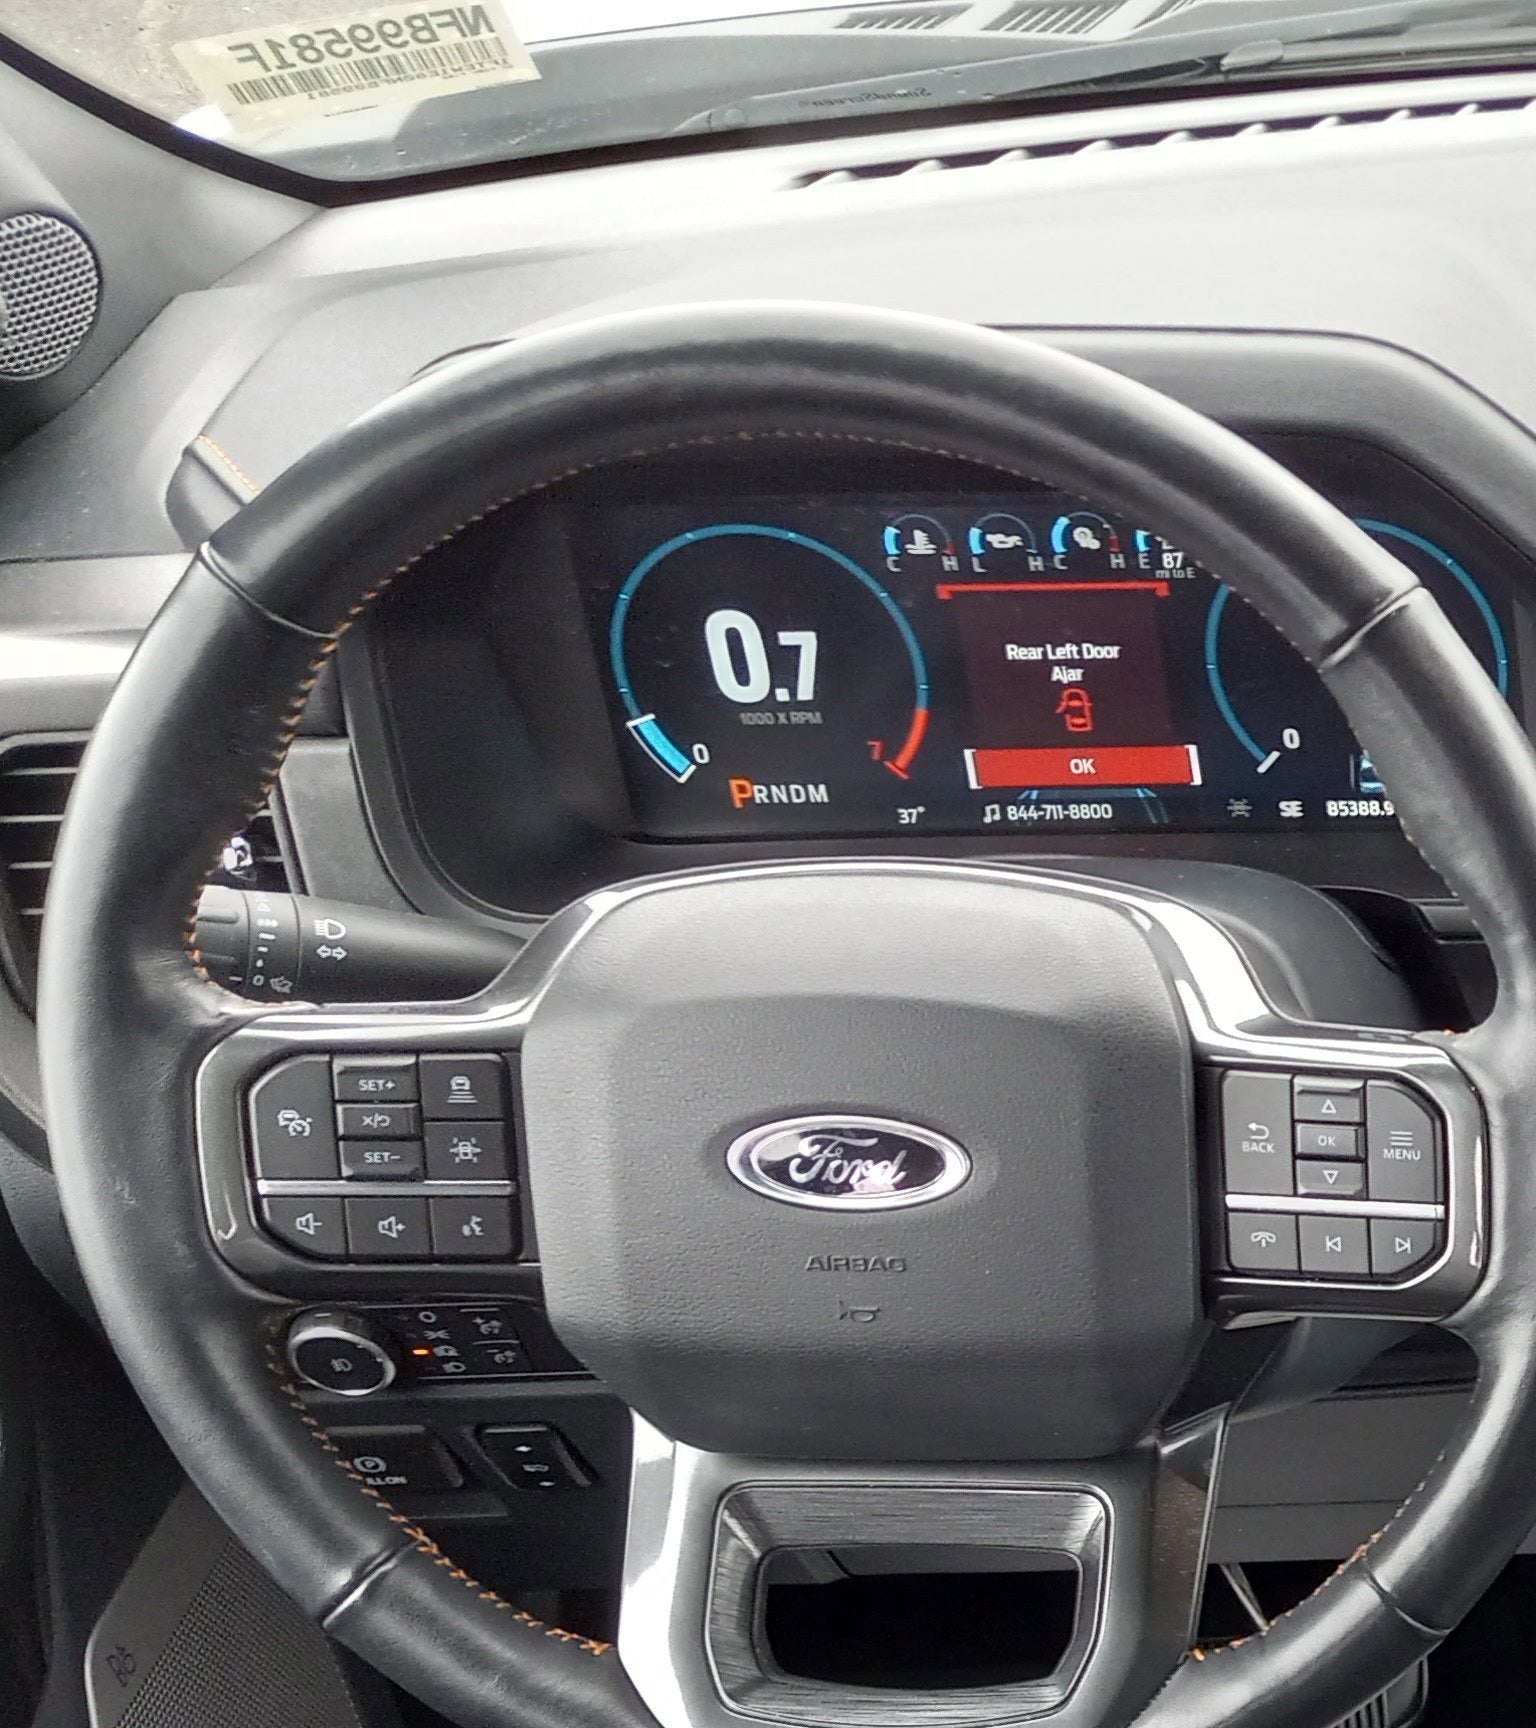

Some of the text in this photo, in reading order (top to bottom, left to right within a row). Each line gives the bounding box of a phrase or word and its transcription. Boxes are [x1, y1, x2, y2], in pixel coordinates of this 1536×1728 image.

[886, 557, 901, 572] C
[942, 555, 959, 571] H
[972, 556, 987, 572] L
[1028, 556, 1045, 571] H
[1053, 554, 1069, 570] C
[1109, 553, 1126, 569] H
[1137, 553, 1150, 569] E
[1162, 552, 1183, 569] 87
[704, 609, 818, 703] 0.7
[1006, 642, 1121, 661] Rear Left Door
[1052, 664, 1084, 685] Ajar
[739, 712, 774, 726] 1000
[791, 712, 822, 725] RPM
[1282, 729, 1300, 749] 0
[692, 743, 710, 764] 0
[866, 741, 884, 760] 7
[1069, 759, 1095, 775] OK
[897, 807, 926, 824] 37°
[1007, 803, 1113, 821] 844-711-8800
[1278, 800, 1304, 818] SE
[358, 1079, 396, 1092] SET+
[1241, 1140, 1275, 1154] BACK
[1317, 1135, 1337, 1147] OK
[789, 1134, 908, 1184] Ford
[1383, 1148, 1422, 1161] MENU
[806, 1254, 907, 1273] AIRBAG
